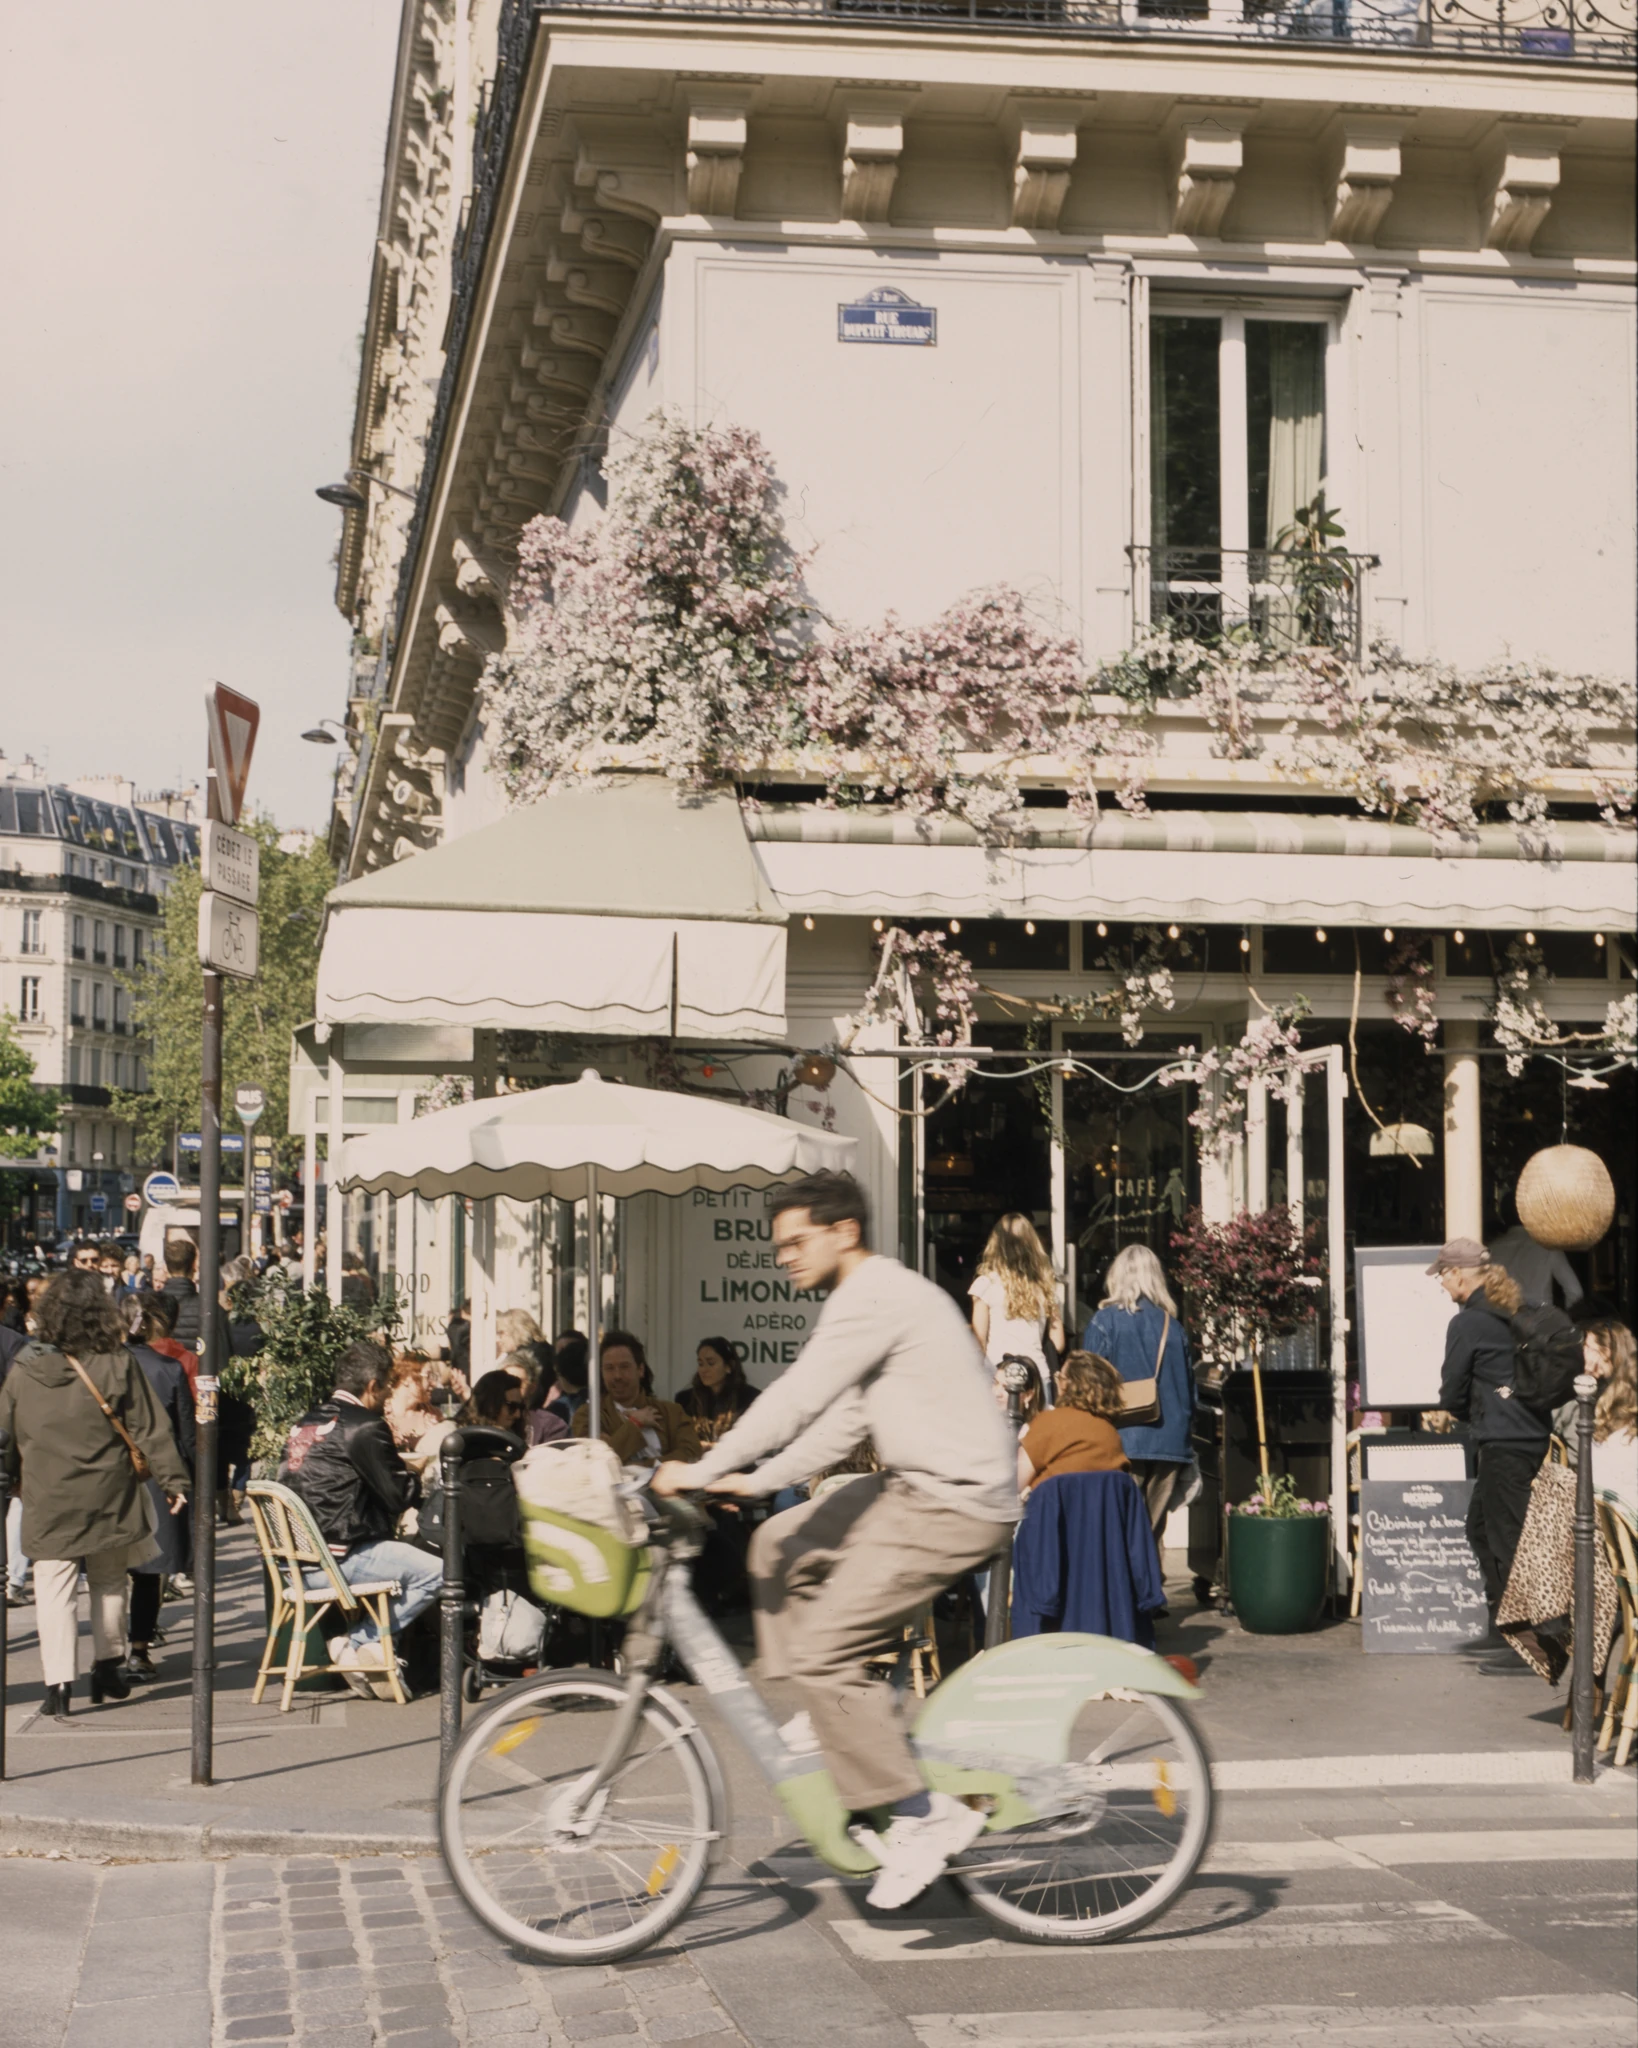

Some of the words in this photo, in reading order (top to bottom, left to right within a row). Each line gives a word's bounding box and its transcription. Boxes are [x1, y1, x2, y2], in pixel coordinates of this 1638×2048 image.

[874, 310, 900, 325] RUE
[216, 833, 241, 862] CÉDEZ
[243, 846, 253, 867] LE
[217, 862, 251, 892] PASSAGE
[237, 1090, 262, 1104] BUS
[1115, 1175, 1156, 1197] CAFÉ
[692, 1189, 752, 1208] PETIT
[714, 1218, 773, 1241] BRU
[700, 1276, 829, 1303] LIMONA
[383, 1315, 448, 1336] RINKS
